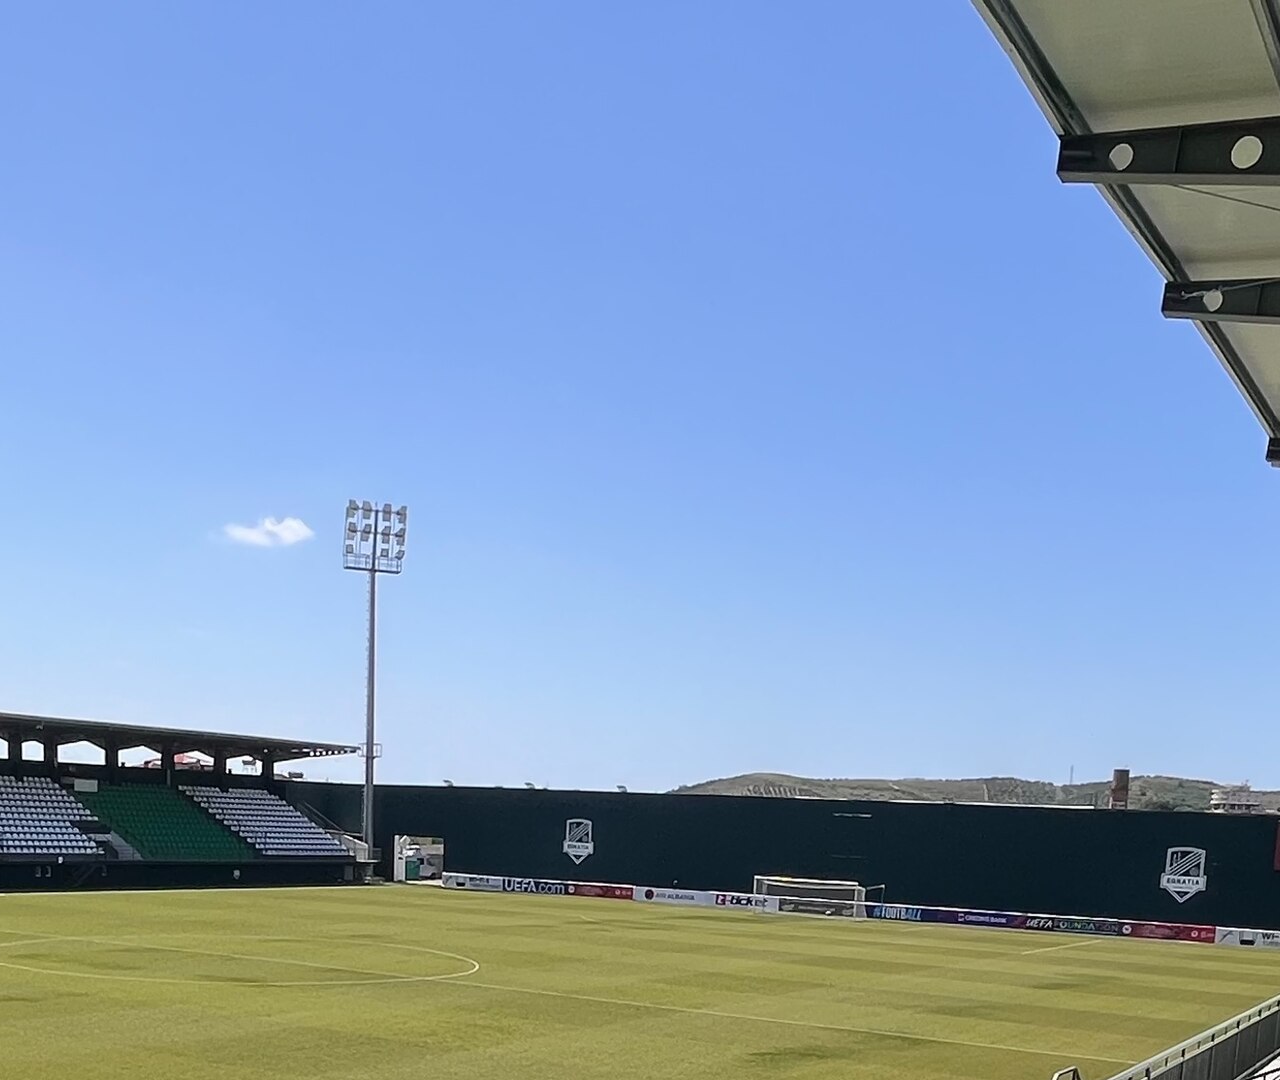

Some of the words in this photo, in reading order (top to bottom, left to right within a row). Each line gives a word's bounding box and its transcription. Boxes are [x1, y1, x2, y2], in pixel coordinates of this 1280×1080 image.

[504, 878, 565, 895] UEFA.com
[873, 906, 921, 920] #FOOTBALL
[1026, 919, 1053, 928] UEFA
